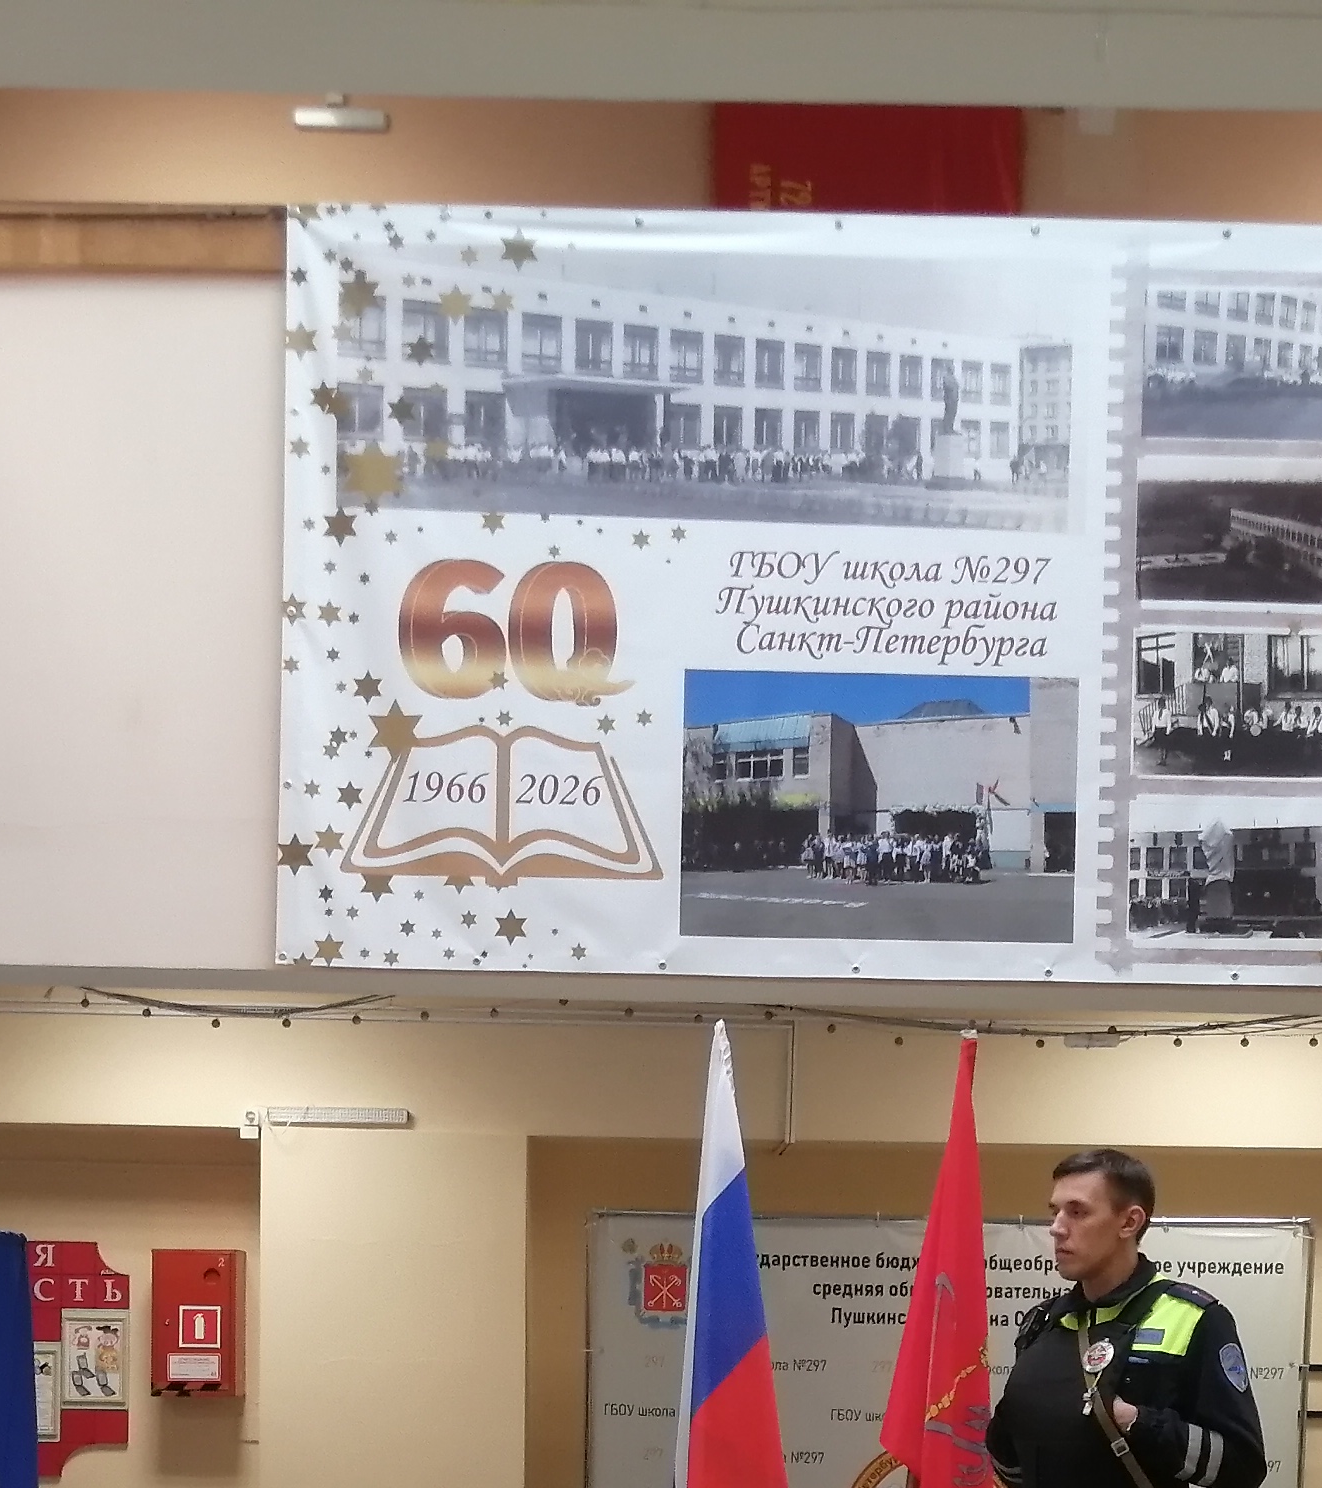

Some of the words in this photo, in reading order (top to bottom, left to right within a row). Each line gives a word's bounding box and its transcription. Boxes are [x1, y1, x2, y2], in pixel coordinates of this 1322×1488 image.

[729, 550, 837, 585] ГБОУ
[843, 556, 941, 587] школа
[950, 554, 1052, 588] №297
[715, 587, 935, 624] Пушкинского
[943, 594, 1058, 630] района
[398, 557, 622, 704] 60
[735, 621, 1049, 666] Санкт-Петербурга
[404, 769, 488, 805] 1966
[515, 772, 603, 807] 2026
[755, 1253, 871, 1271] дарственное
[1177, 1260, 1285, 1278] учреждение
[812, 1282, 884, 1300] средняя
[830, 1306, 907, 1329] Пушкинс
[604, 1403, 635, 1417] ГБОУ
[638, 1407, 676, 1418] школа
[830, 1408, 862, 1421] ГБОУ
